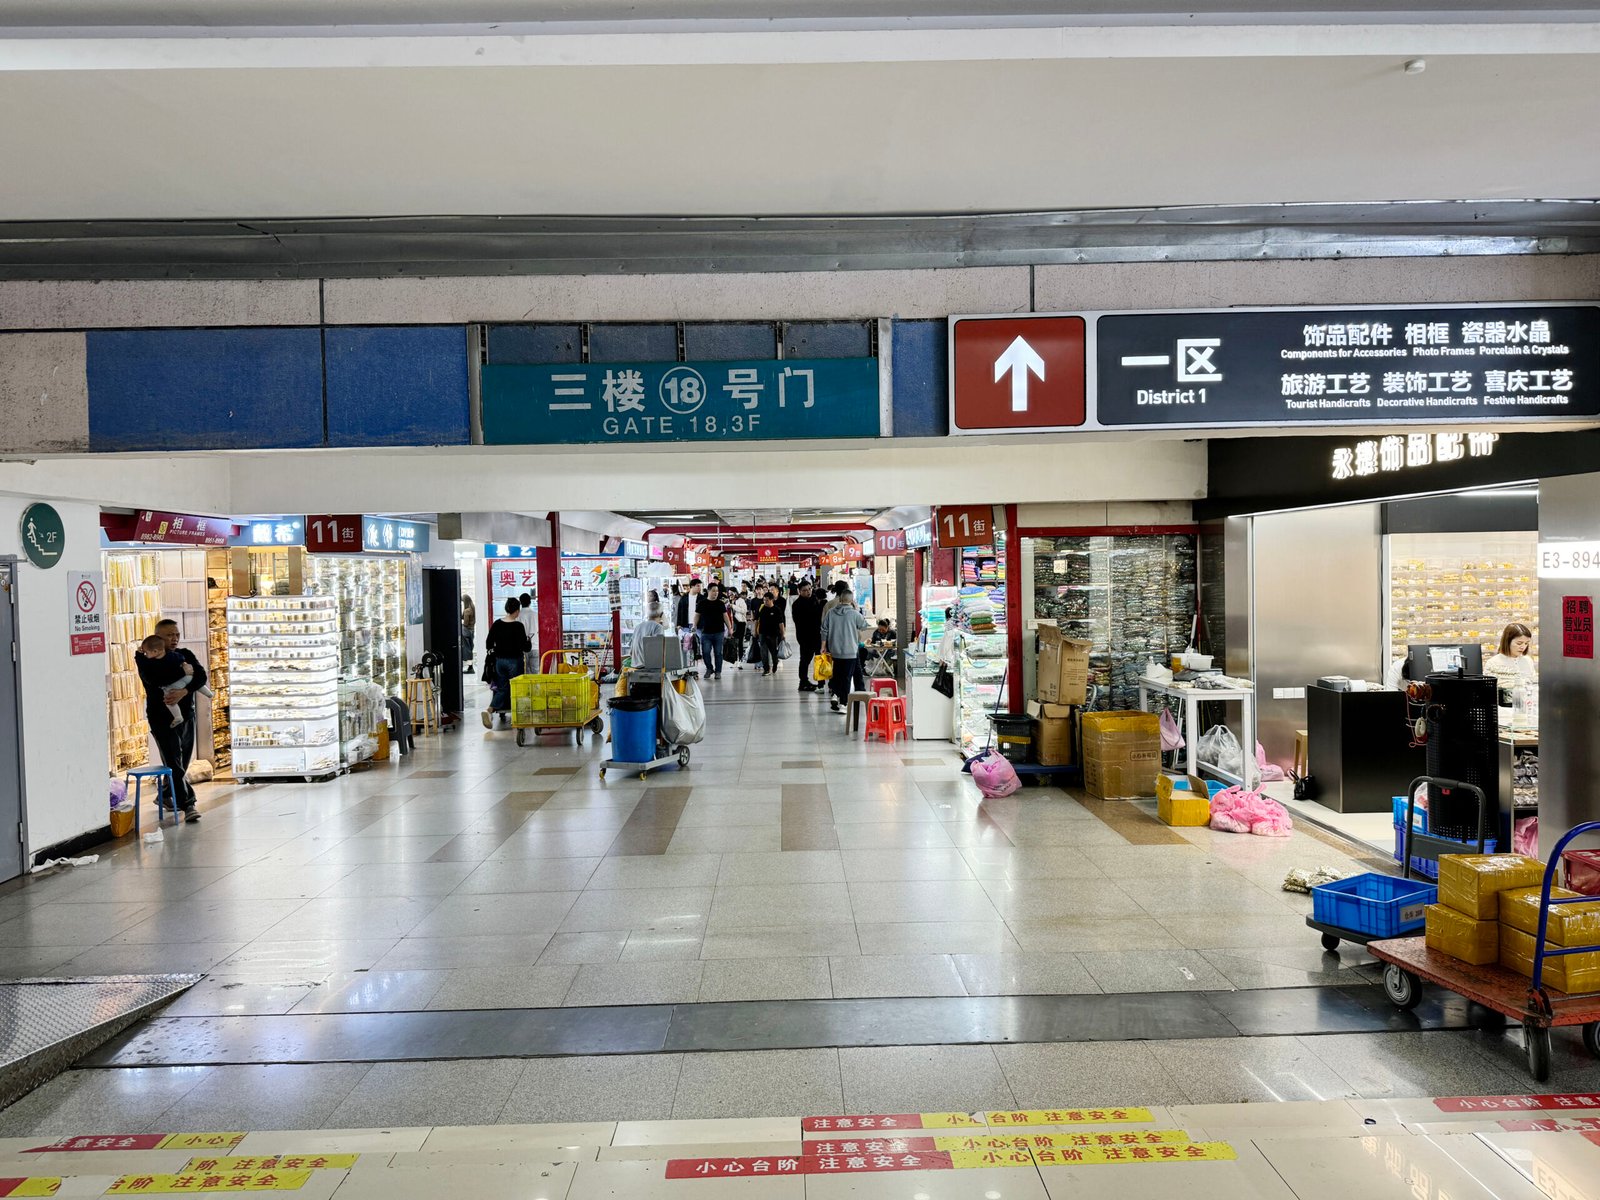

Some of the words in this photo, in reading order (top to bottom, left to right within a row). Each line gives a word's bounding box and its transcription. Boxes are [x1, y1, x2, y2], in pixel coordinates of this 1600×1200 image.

[1303, 323, 1393, 346] 饰品配件
[1405, 322, 1449, 345] 相框
[1462, 320, 1551, 343] 瓷器水晶
[1281, 349, 1337, 360] Components
[1339, 349, 1352, 357] for
[1353, 347, 1407, 357] Accessories
[1413, 346, 1439, 356] Photo
[1441, 346, 1475, 355] Frames
[1479, 345, 1521, 355] Porcelain
[1523, 345, 1530, 354] &
[1532, 344, 1569, 356] Crystals
[1121, 338, 1222, 382] 一区
[1281, 372, 1371, 395] 旅游工艺
[1383, 371, 1472, 393] 装饰工艺
[1485, 369, 1573, 392] 喜庆工艺
[1137, 389, 1195, 404] District
[1199, 388, 1206, 402] 1
[1286, 399, 1317, 408] Tourist
[1319, 398, 1371, 407] Handicrafts
[1377, 397, 1424, 407] Decorative
[1426, 396, 1478, 406] Handicrafts
[1484, 395, 1515, 405] Festive
[1517, 394, 1568, 404] Handicrafts
[603, 417, 673, 434] GATE
[173, 517, 207, 531] 相框
[47, 532, 57, 543] 2F
[814, 1116, 898, 1128] 注意安全
[1044, 1109, 1129, 1122] 注意安全
[1072, 1132, 1164, 1146] 注意安全
[982, 1148, 1083, 1163] 小心台阶
[1103, 1144, 1207, 1160] 注意安全
[233, 1157, 328, 1170] 注意安全
[696, 1158, 799, 1174] 小心台阶
[819, 1154, 922, 1170] 注意安全
[170, 1174, 279, 1188] 注意安全
